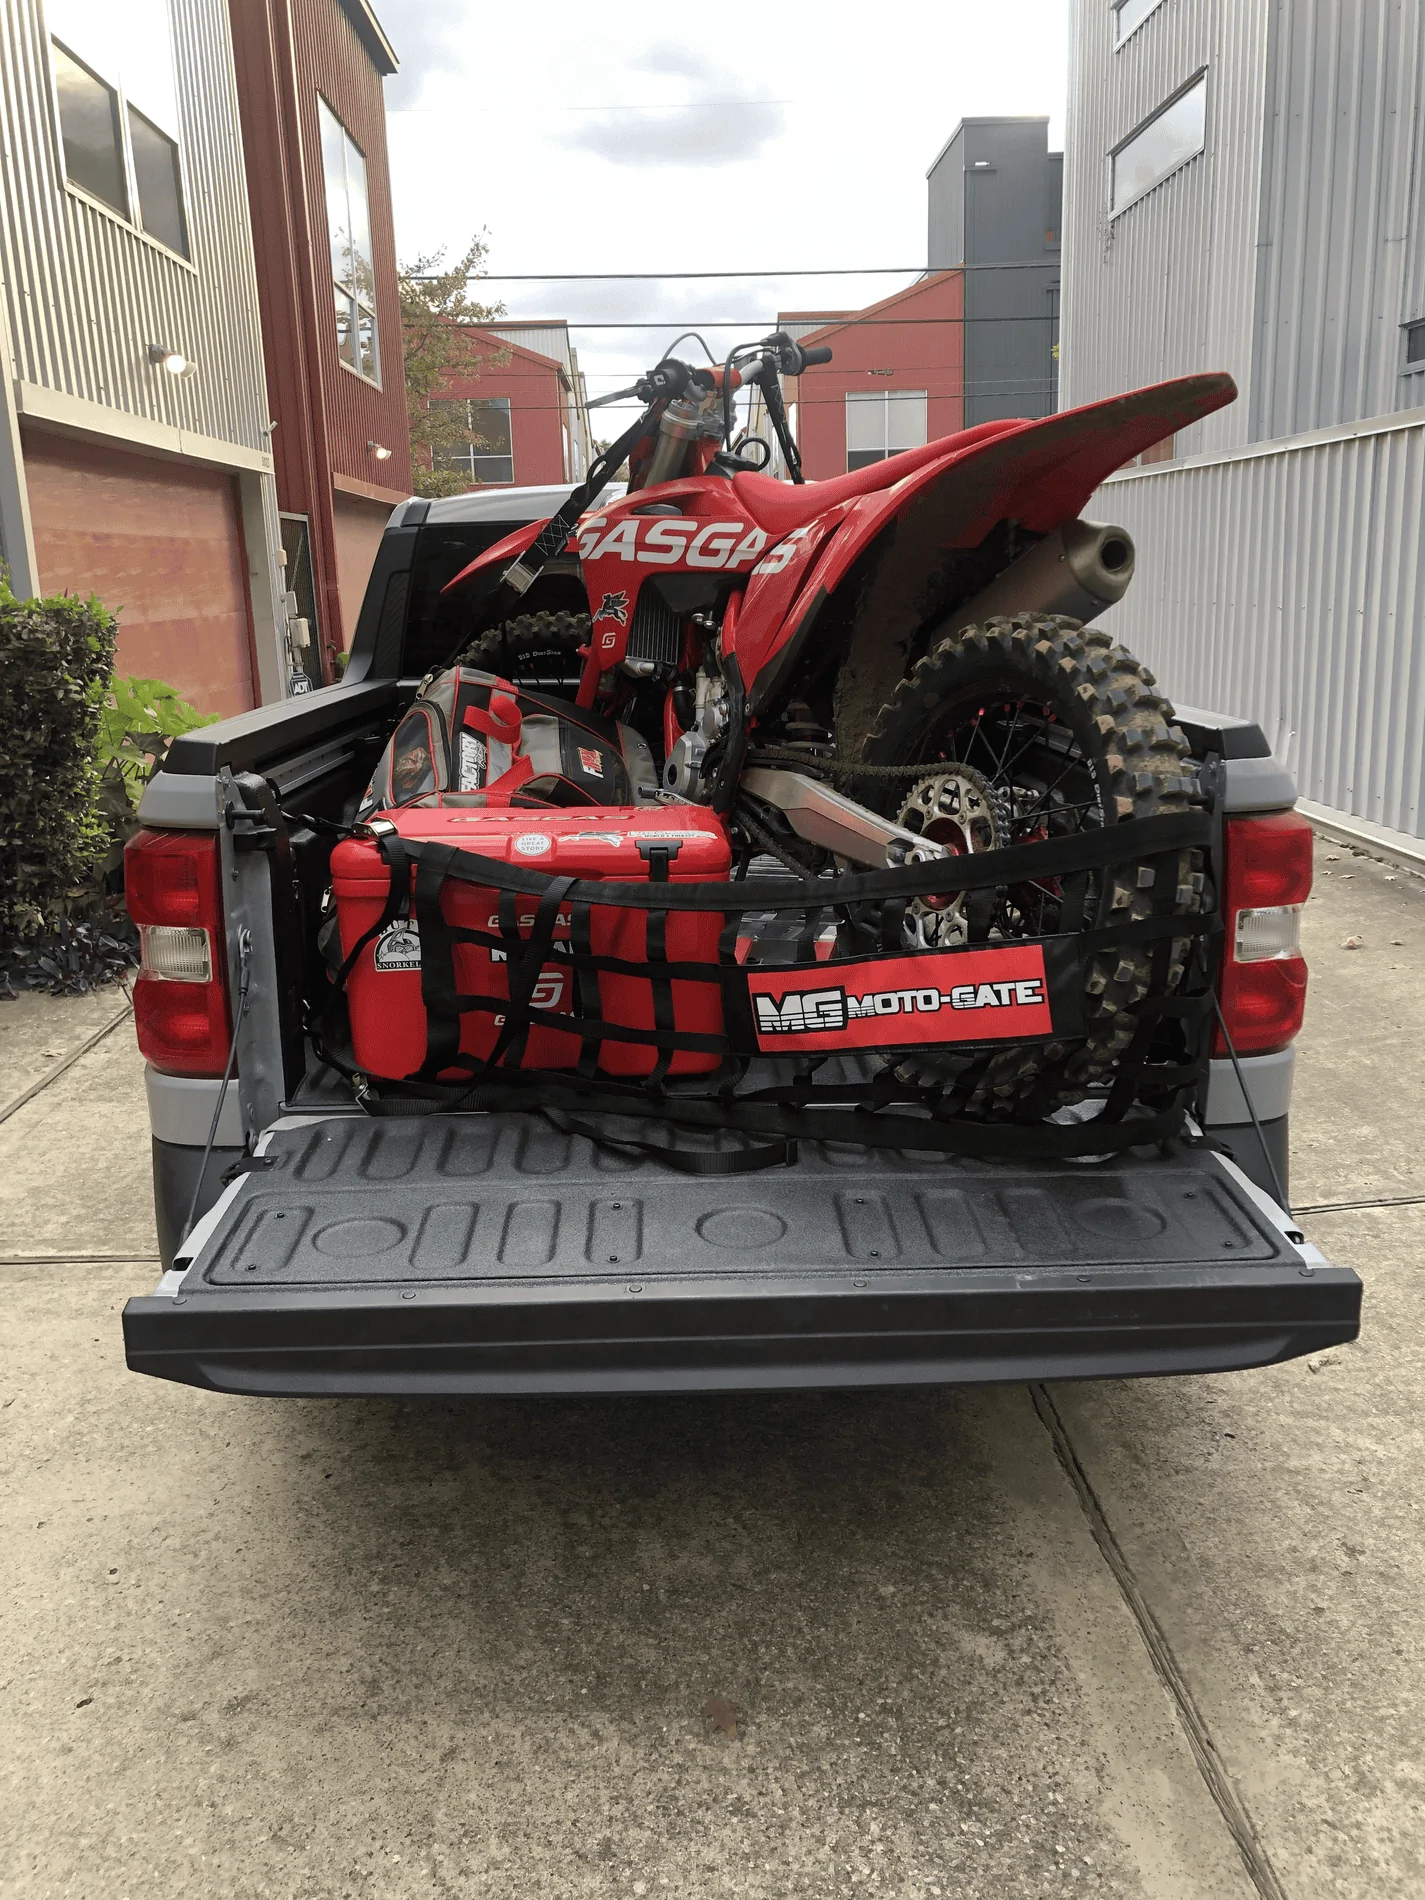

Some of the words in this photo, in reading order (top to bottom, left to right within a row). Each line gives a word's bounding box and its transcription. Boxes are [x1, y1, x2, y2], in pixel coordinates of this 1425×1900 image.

[577, 517, 805, 576] GASGAS
[460, 732, 478, 793] FACTORY
[755, 989, 844, 1033] MG
[846, 979, 1044, 1019] MOTO-GATE
